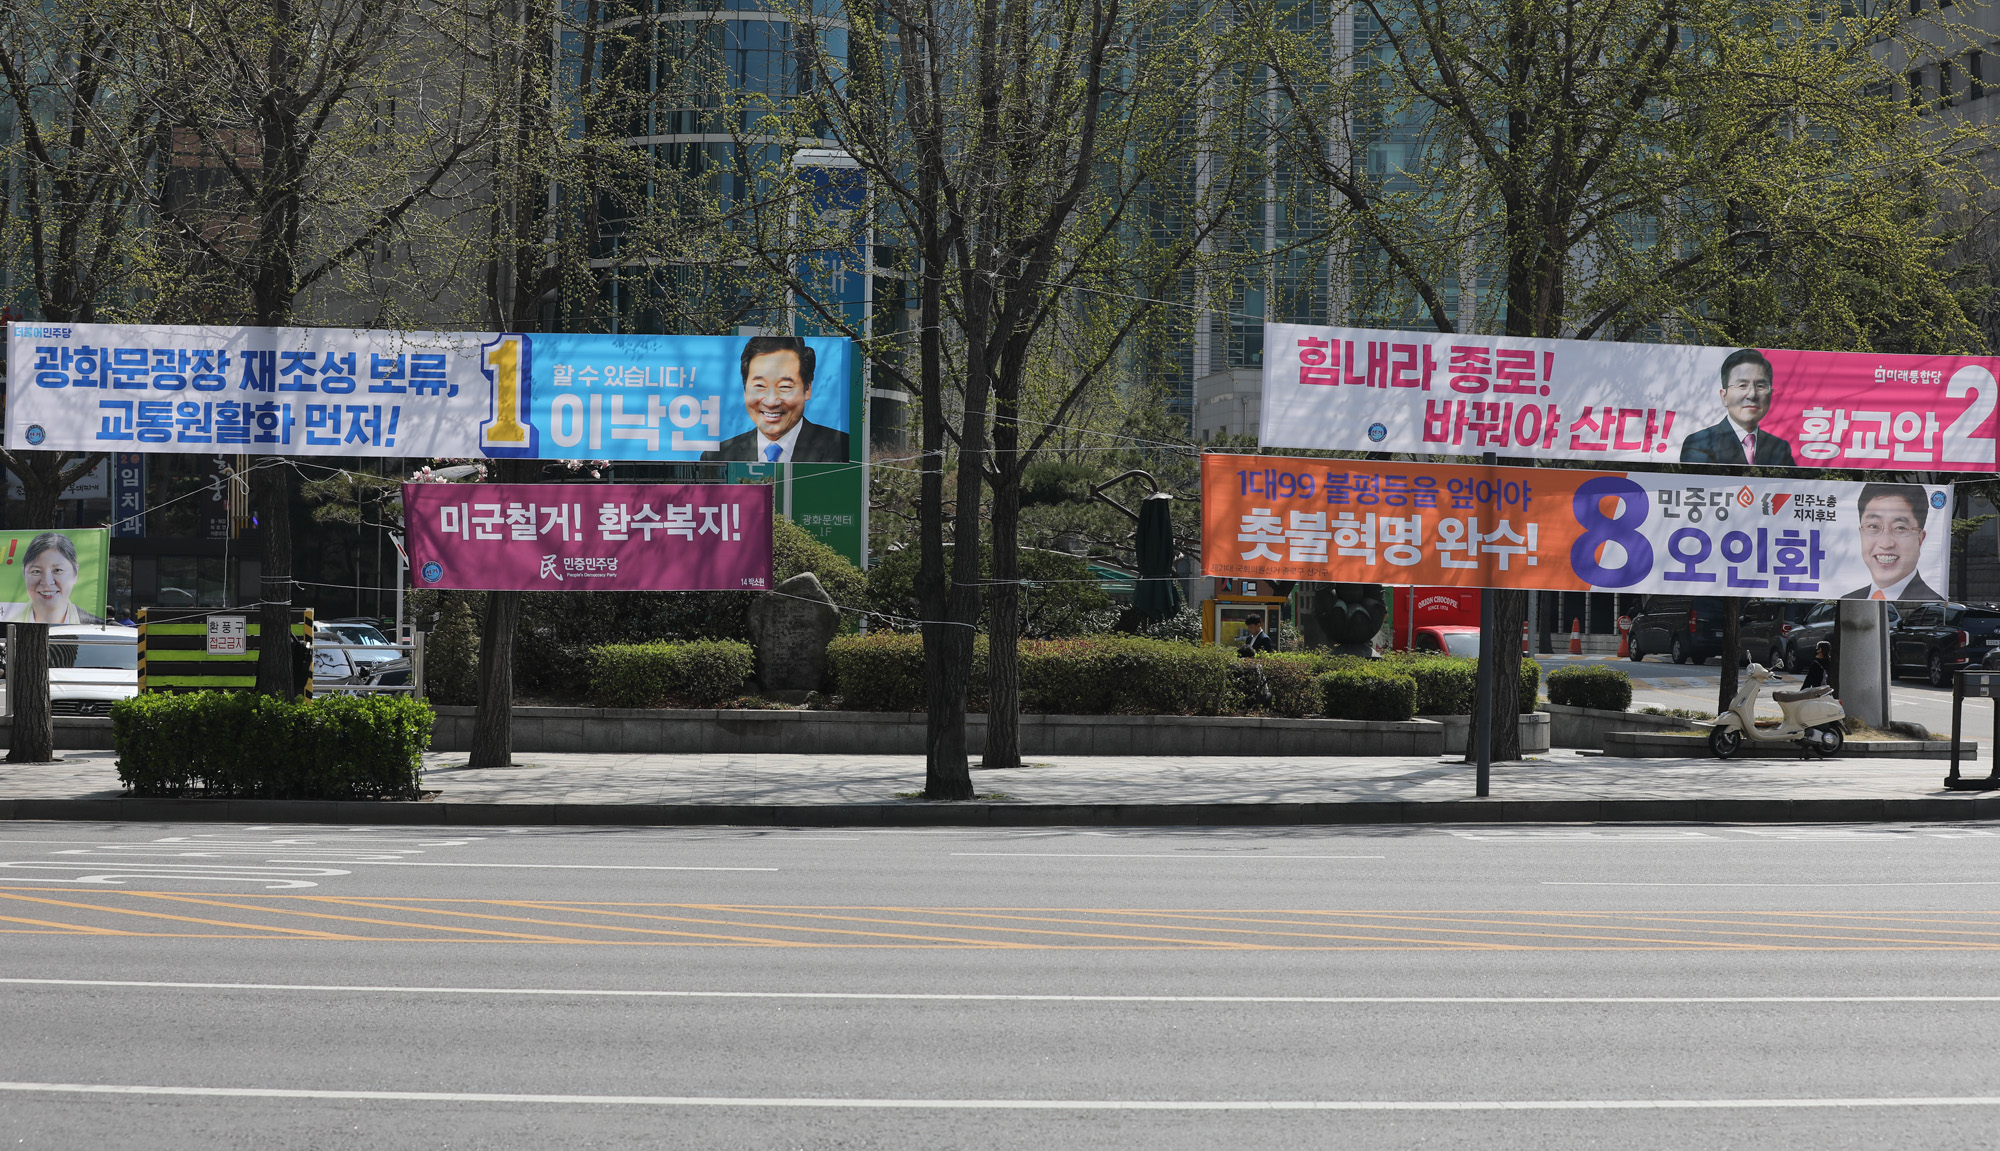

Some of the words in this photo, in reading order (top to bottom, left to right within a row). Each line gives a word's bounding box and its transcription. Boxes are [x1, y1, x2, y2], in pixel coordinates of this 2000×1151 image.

[14, 327, 72, 338] 더불어민주당
[34, 344, 230, 393] 광화문광장
[239, 350, 356, 396] 재조성
[368, 352, 459, 398] 보류,
[552, 364, 574, 387] 할
[578, 365, 598, 387] 수
[604, 364, 696, 388] 있습니다!
[1297, 336, 1437, 391] 힘내라
[1449, 345, 1555, 397] 종로!
[1886, 370, 1942, 384] 미래통합당
[481, 335, 535, 453] 1
[96, 400, 296, 446] 교통원활화
[305, 403, 400, 448] 먼저!
[550, 392, 720, 452] 이낙연
[1422, 399, 1560, 449] 바꿔야
[1570, 406, 1676, 455] 산다!
[1942, 364, 1998, 464] 2
[1798, 406, 1940, 463] 황교안
[1236, 468, 1316, 502] 1대99
[1324, 472, 1440, 509] 불평등을
[1447, 477, 1532, 512] 엎어야
[1658, 487, 1734, 523] 민중당
[1794, 494, 1837, 508] 민주노총
[440, 502, 583, 541] 미군철거!
[598, 502, 741, 541] 환수복지!
[803, 514, 852, 526] 광화문센터
[820, 527, 832, 536] 1F
[1570, 476, 1654, 588] 8
[1794, 509, 1836, 522] 지지후보
[1238, 507, 1422, 566] 촛불혁명
[1435, 517, 1538, 572] 완수!
[540, 554, 564, 581] 民
[564, 558, 618, 570] 민중민주당
[1212, 564, 1234, 573] 제21대
[1236, 564, 1280, 574] 국회의원선거
[1306, 567, 1328, 577] 선거구
[1664, 527, 1825, 592] 오인환
[741, 578, 748, 586] 14
[210, 637, 244, 649] 접근금지
